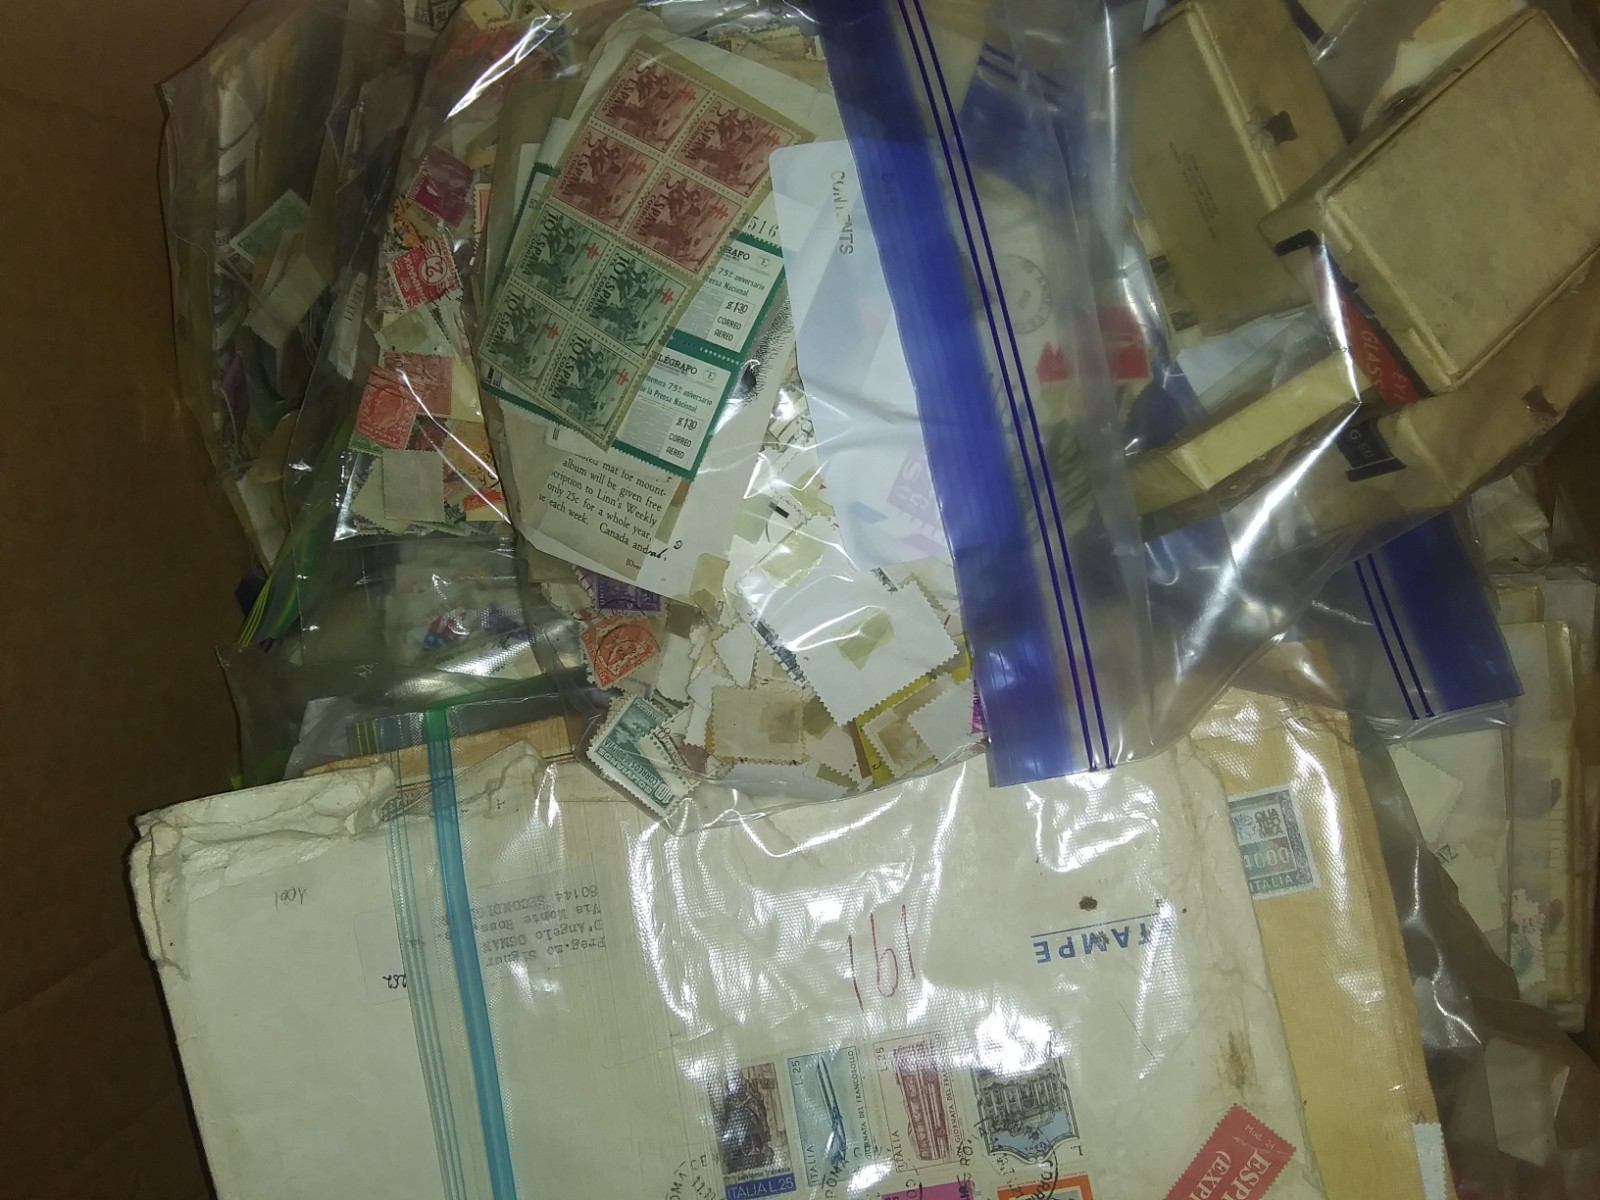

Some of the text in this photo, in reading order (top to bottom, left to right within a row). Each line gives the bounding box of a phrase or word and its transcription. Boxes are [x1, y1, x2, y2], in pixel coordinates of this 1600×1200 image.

[724, 282, 750, 297] Nacional
[734, 274, 766, 291] aniversario
[586, 276, 607, 312] CORREOS
[718, 316, 742, 331] CORREO
[714, 328, 734, 342] AEREO
[654, 390, 672, 403] Prensa
[673, 398, 698, 413] Nacional
[683, 390, 713, 406] aniversario
[669, 432, 692, 448] CORREO
[666, 446, 685, 459] AEREO
[562, 458, 587, 476] album
[590, 472, 606, 485] will
[607, 479, 617, 491] be
[620, 486, 642, 503] given
[646, 496, 662, 513] free
[636, 479, 666, 497] mount-
[547, 482, 564, 497] only
[566, 491, 580, 504] 25c
[582, 498, 595, 512] for
[606, 512, 630, 529] whole
[632, 525, 652, 542] year,
[585, 485, 593, 495] to
[597, 489, 622, 509] Linn's
[626, 502, 658, 528] Weekly
[549, 500, 566, 513] each
[568, 508, 589, 525] week.
[599, 522, 630, 545] Canada
[632, 542, 649, 555] and
[598, 747, 653, 794] BOLIVIANOS
[629, 762, 659, 788] CORREOS
[1249, 874, 1293, 893] ITALIA
[576, 903, 602, 916] Via
[1033, 917, 1172, 964] TAMPE
[790, 1060, 804, 1086] L.25
[858, 1107, 866, 1119] DEL
[949, 1104, 961, 1143] GIORNATA
[805, 1144, 819, 1184] ITALIA
[727, 1182, 765, 1200] ITALIA
